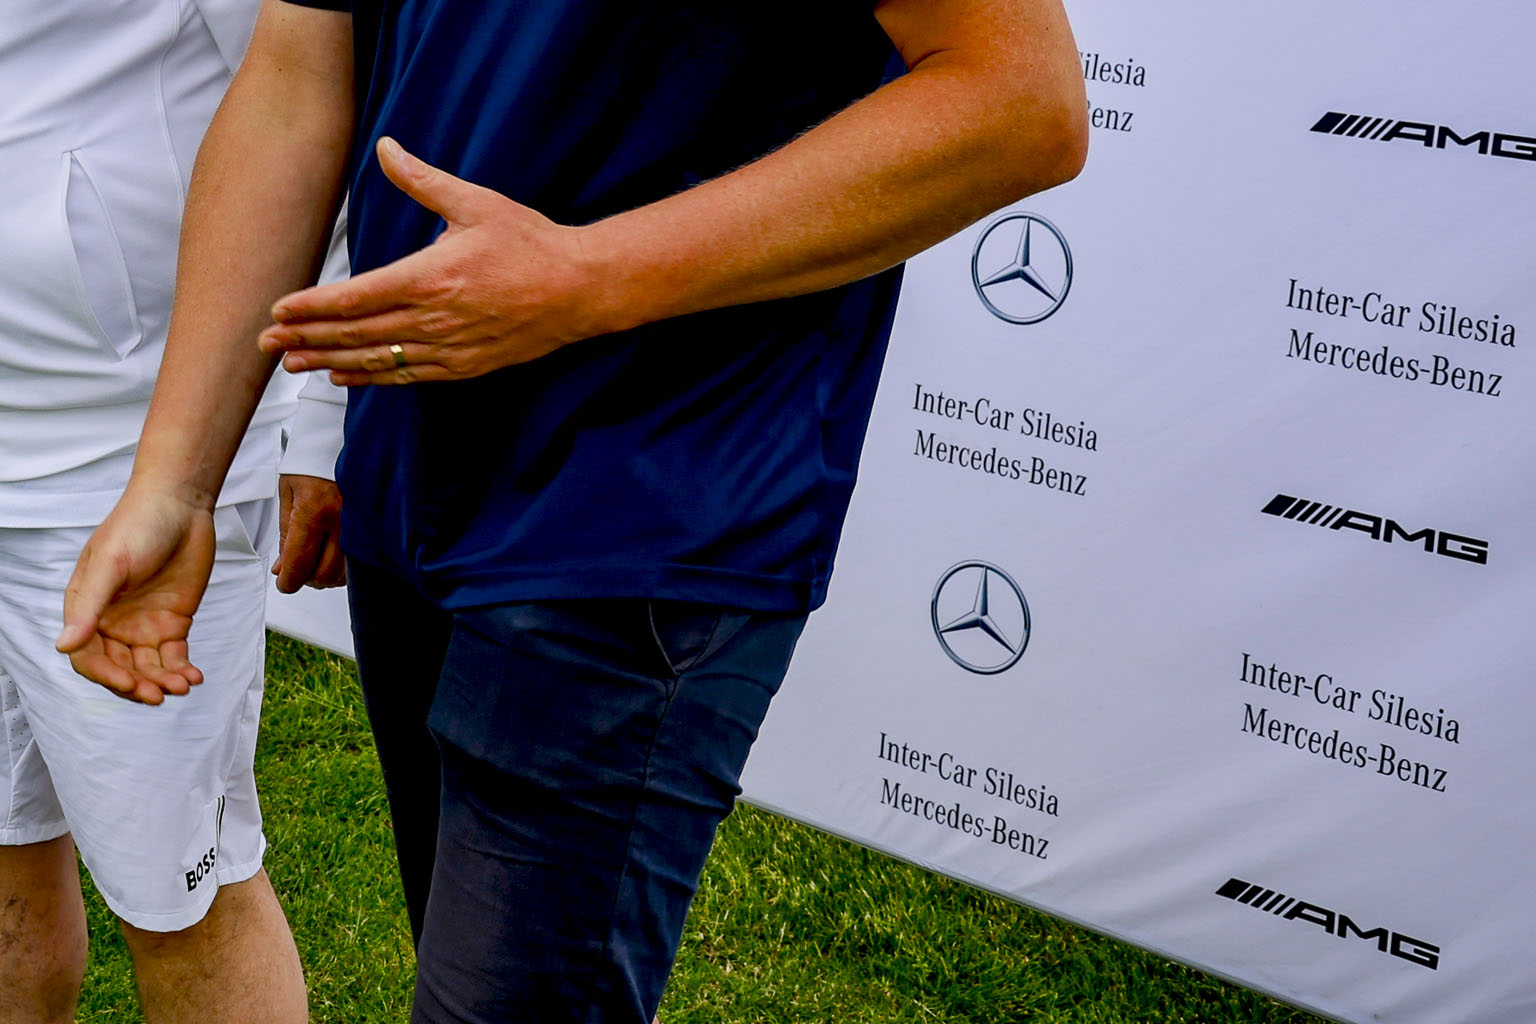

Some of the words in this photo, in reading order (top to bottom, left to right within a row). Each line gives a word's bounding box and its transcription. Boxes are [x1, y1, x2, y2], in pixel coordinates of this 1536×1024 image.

[1081, 52, 1146, 88] ilesia
[1286, 279, 1411, 327] Inter-Car
[1419, 302, 1515, 347] Silesia
[1286, 329, 1502, 397] Mercedes-Benz
[913, 384, 1014, 431] Inter-Car
[1021, 409, 1097, 451] Silesia
[914, 429, 1087, 496] Mercedes-Benz
[1329, 510, 1488, 565] AMG
[1240, 653, 1361, 712] Inter-Car
[1368, 690, 1459, 744] Silesia
[878, 732, 977, 788] Inter-Car
[984, 768, 1058, 817] Silesia
[1241, 704, 1447, 792] Mercedes-Benz
[880, 778, 1049, 859] Mercedes-Benz
[184, 846, 216, 893] BOSS
[1283, 901, 1440, 970] AMG
